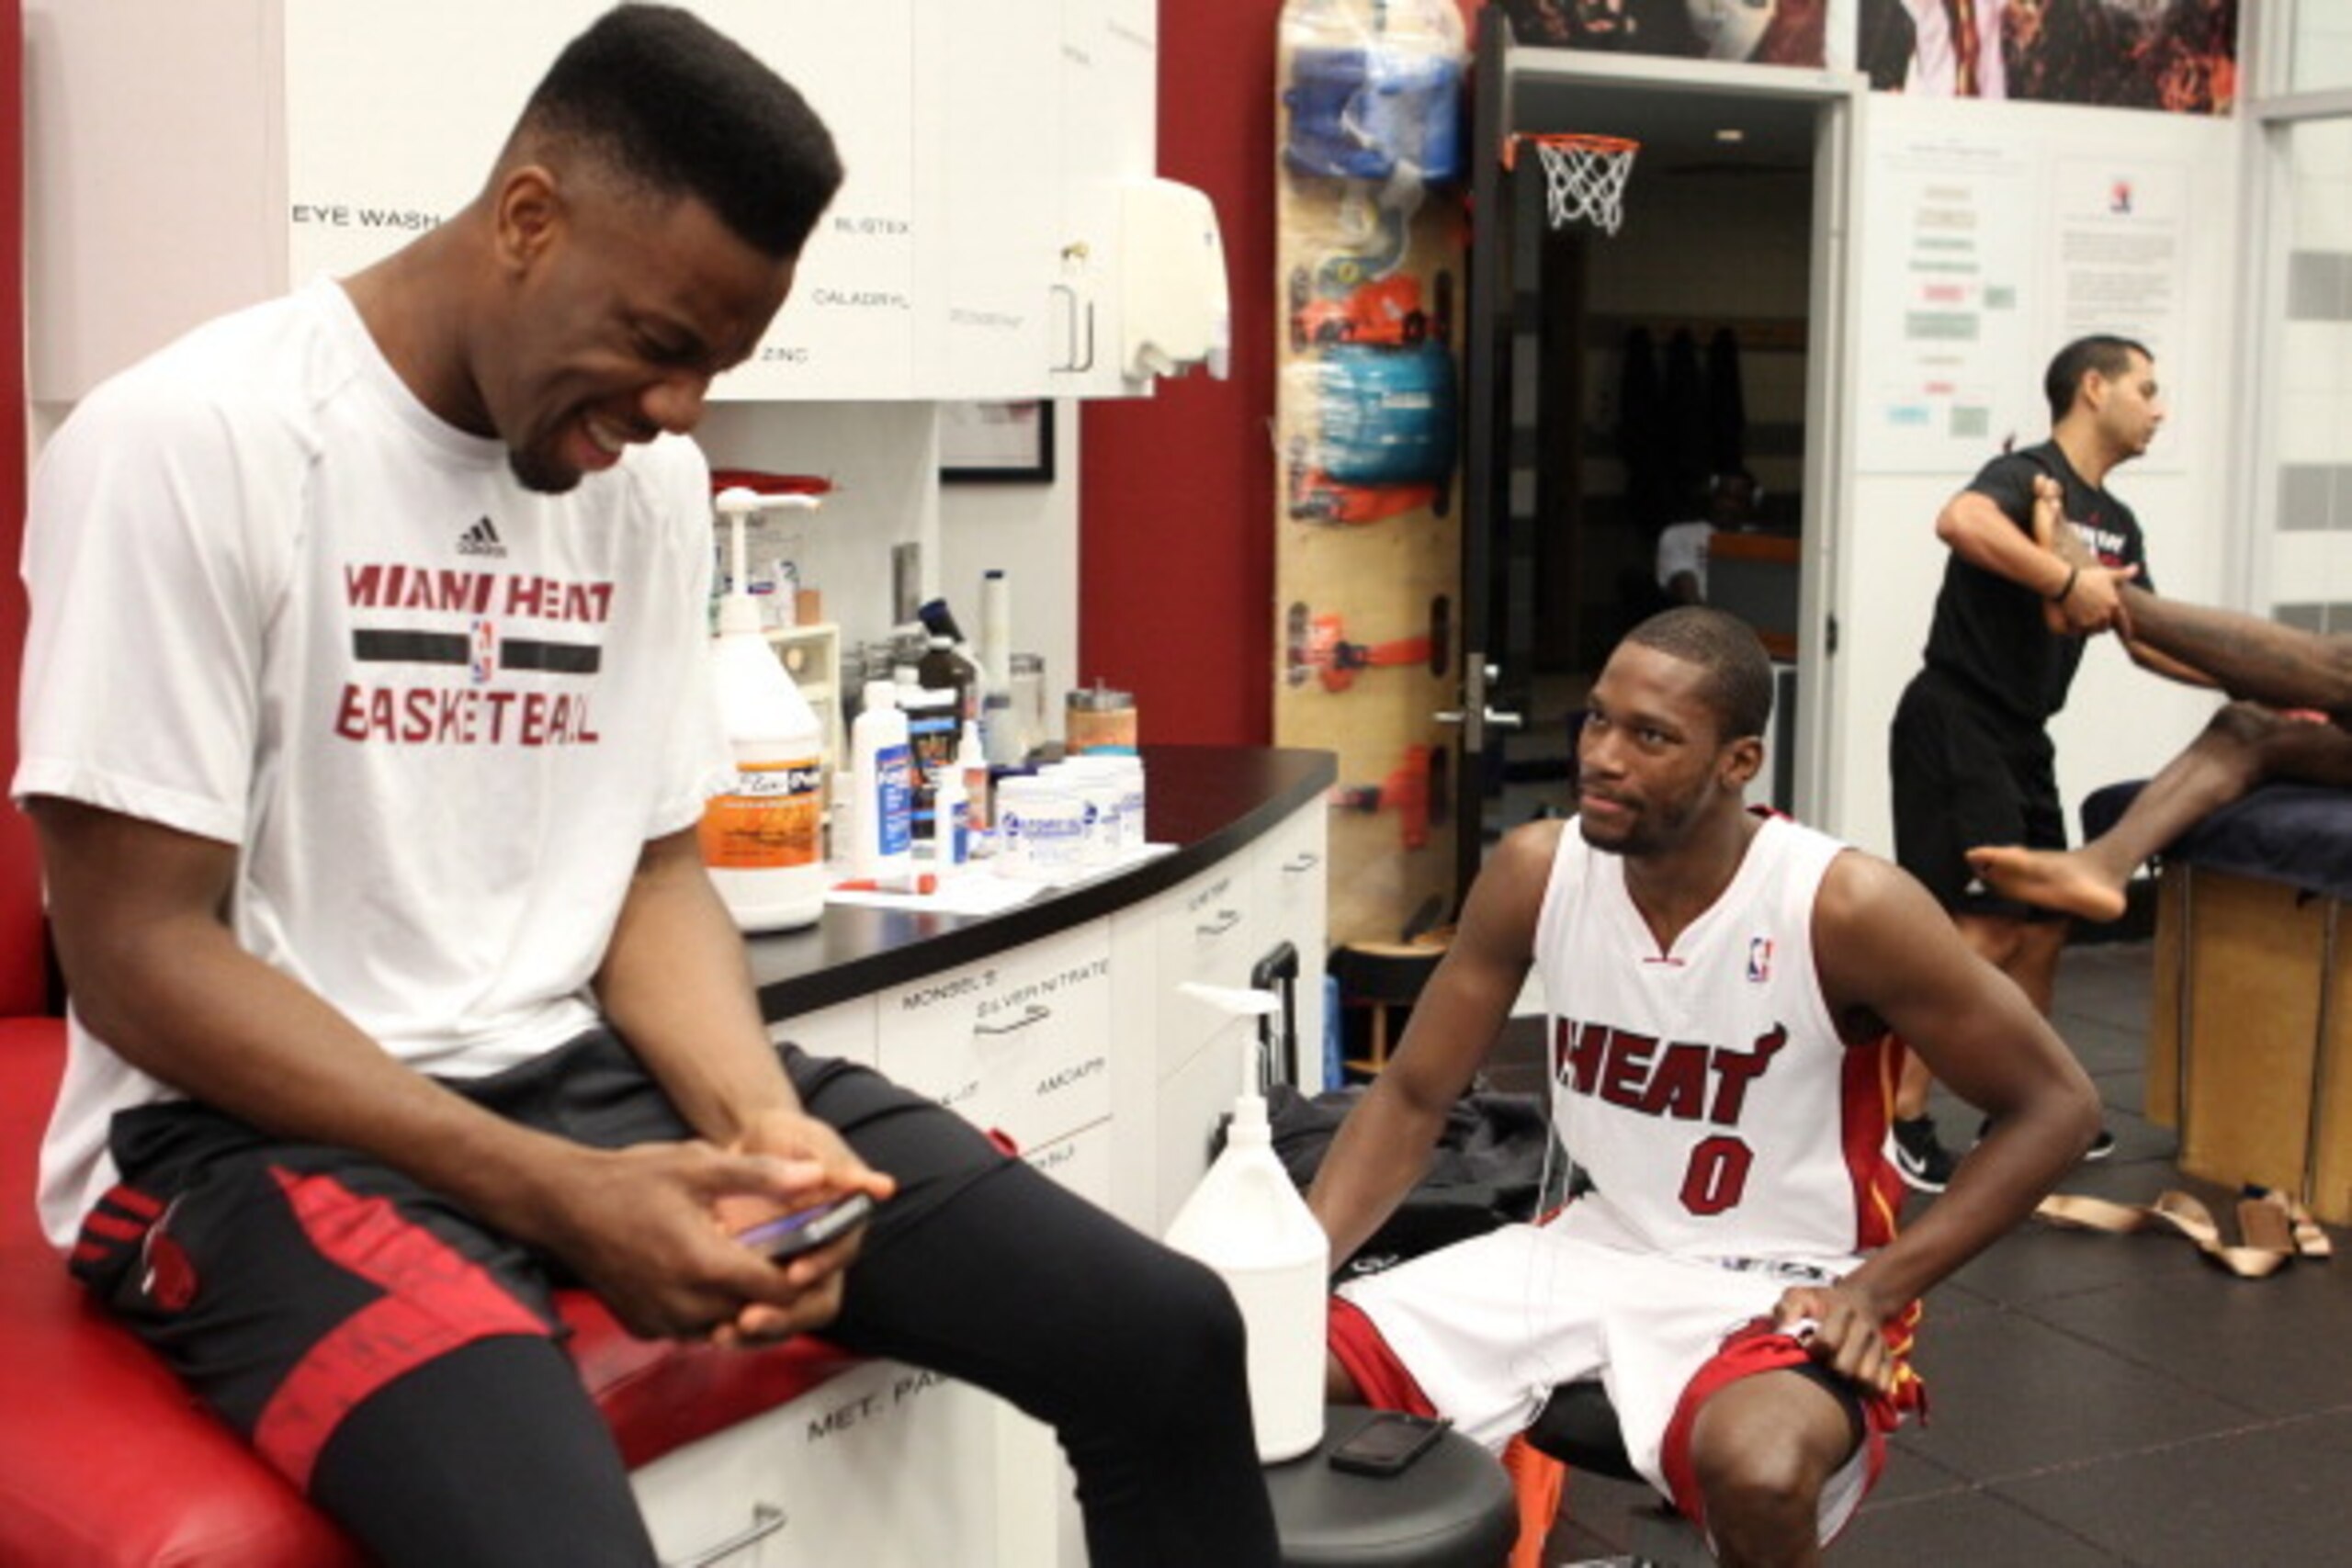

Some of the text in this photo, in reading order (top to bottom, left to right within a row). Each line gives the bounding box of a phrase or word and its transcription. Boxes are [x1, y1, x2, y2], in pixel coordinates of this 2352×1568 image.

[292, 204, 440, 230] EYE WASH
[812, 288, 911, 310] CALADRYL
[345, 564, 614, 623] MIAMI HEAT
[334, 682, 599, 746] BASKETBAL
[1556, 1013, 1787, 1127] HEAT
[1679, 1134, 1754, 1217] 0
[808, 1395, 883, 1441] MET.
